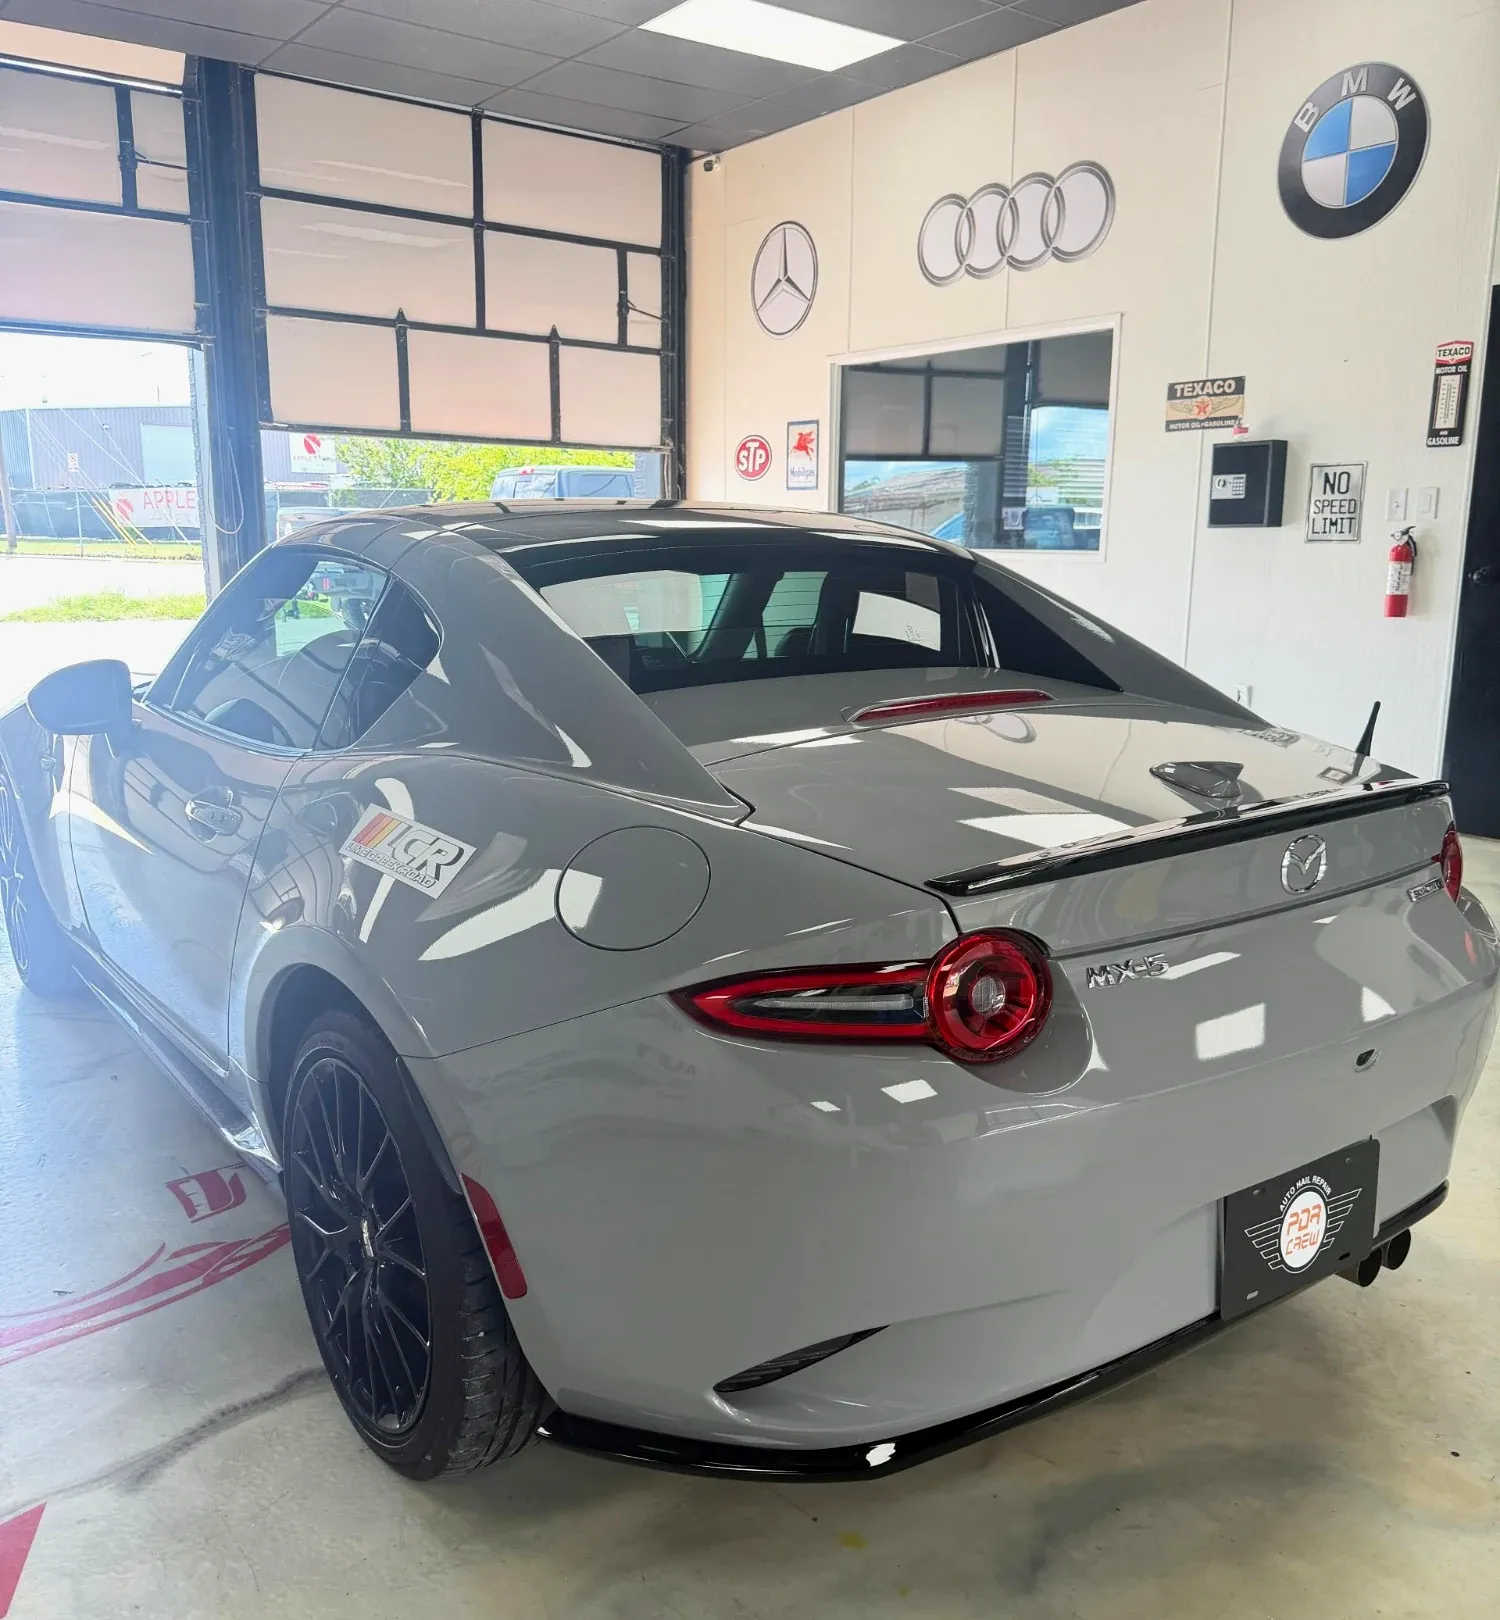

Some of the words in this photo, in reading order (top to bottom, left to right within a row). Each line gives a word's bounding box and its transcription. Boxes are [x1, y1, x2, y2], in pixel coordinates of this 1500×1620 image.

[1294, 68, 1416, 132] BMW
[1437, 347, 1470, 357] TEXACO
[1436, 366, 1456, 374] MOTOR
[1174, 379, 1236, 397] TEXACO
[1169, 421, 1190, 430] MOTOR
[1427, 436, 1459, 446] GASOLINE
[738, 441, 766, 473] STP
[1323, 471, 1351, 495] NO
[143, 489, 196, 509] APPLE
[1313, 498, 1357, 514] SPEED
[1312, 517, 1356, 534] LIMIT
[373, 822, 465, 881] LCR
[1086, 953, 1169, 989] MX-5
[1279, 1187, 1296, 1212] AUTO
[1296, 1175, 1311, 1189] HAIL
[1312, 1175, 1332, 1196] REPAIR
[1287, 1204, 1322, 1236] PDR
[1285, 1229, 1320, 1256] CREW
